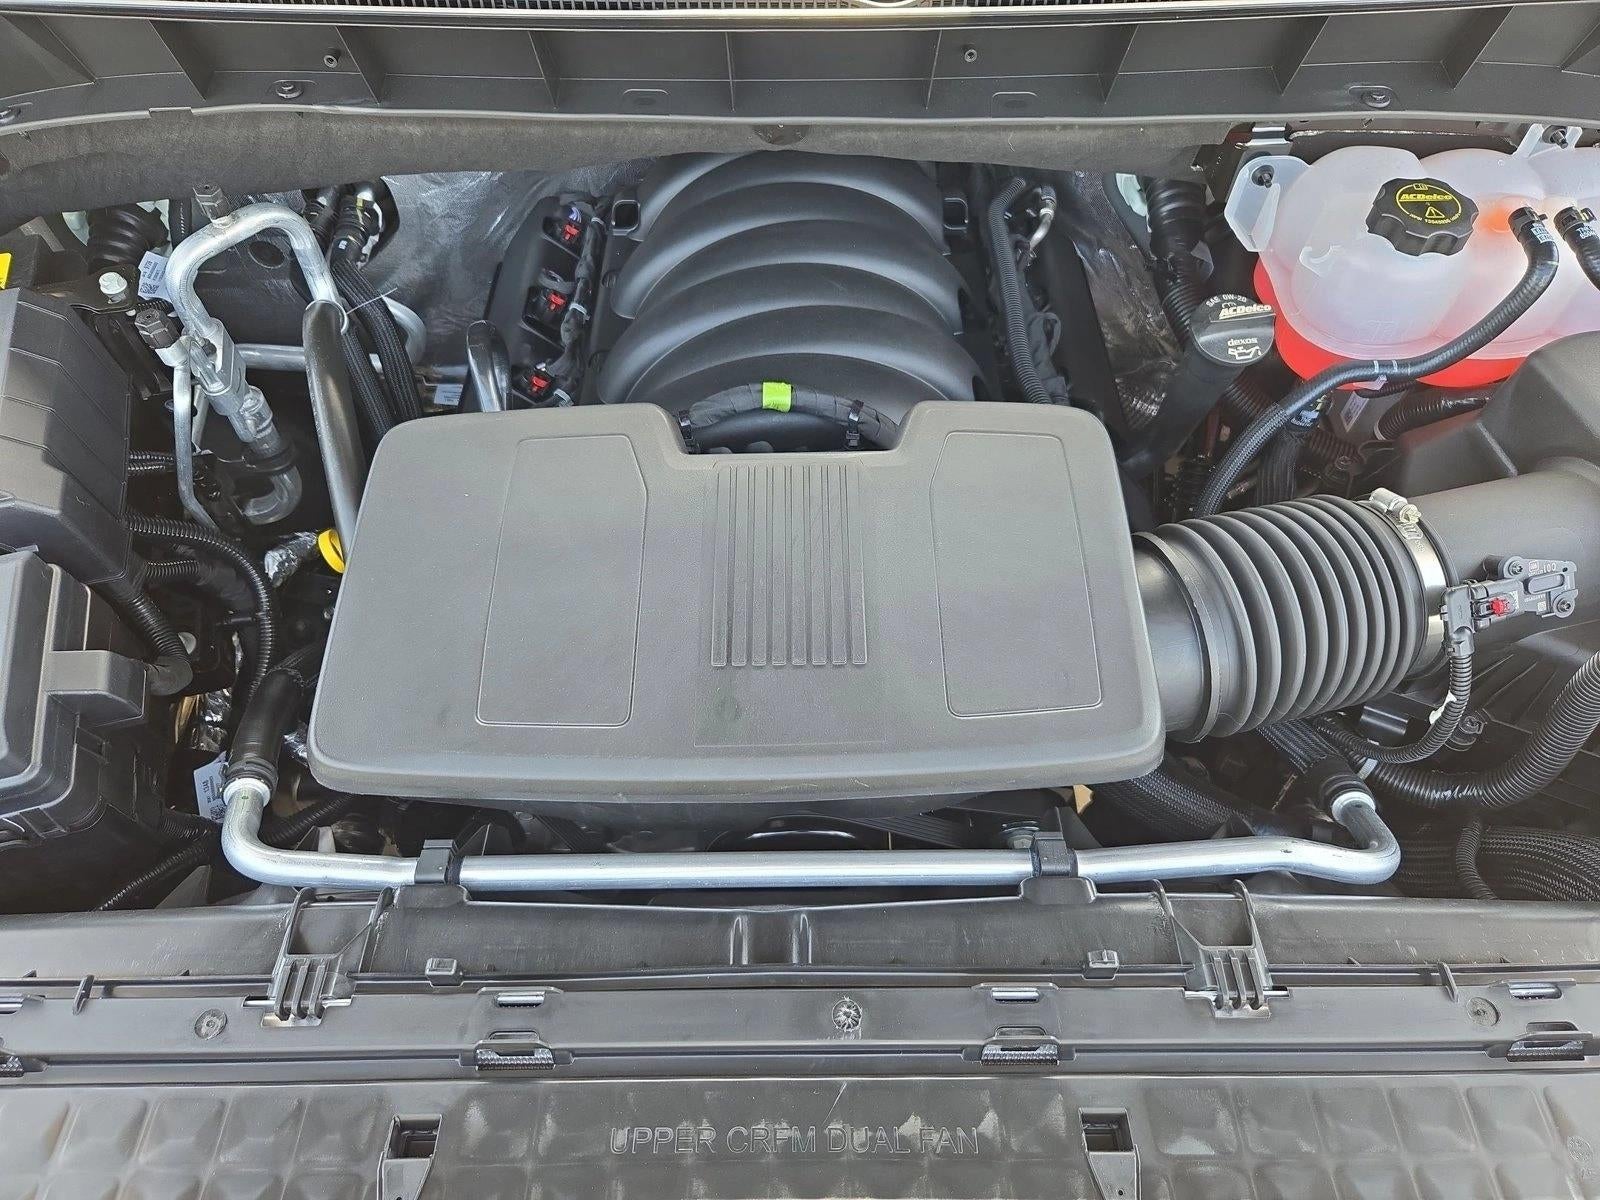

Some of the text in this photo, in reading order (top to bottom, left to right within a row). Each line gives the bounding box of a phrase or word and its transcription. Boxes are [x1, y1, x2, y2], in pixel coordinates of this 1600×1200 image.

[1400, 193, 1453, 201] ACDelco
[1205, 296, 1221, 308] SAE
[1218, 303, 1273, 318] ACDelco
[1227, 337, 1258, 347] dexos
[610, 1125, 979, 1155] UPPER CRFM DUAL FAN
